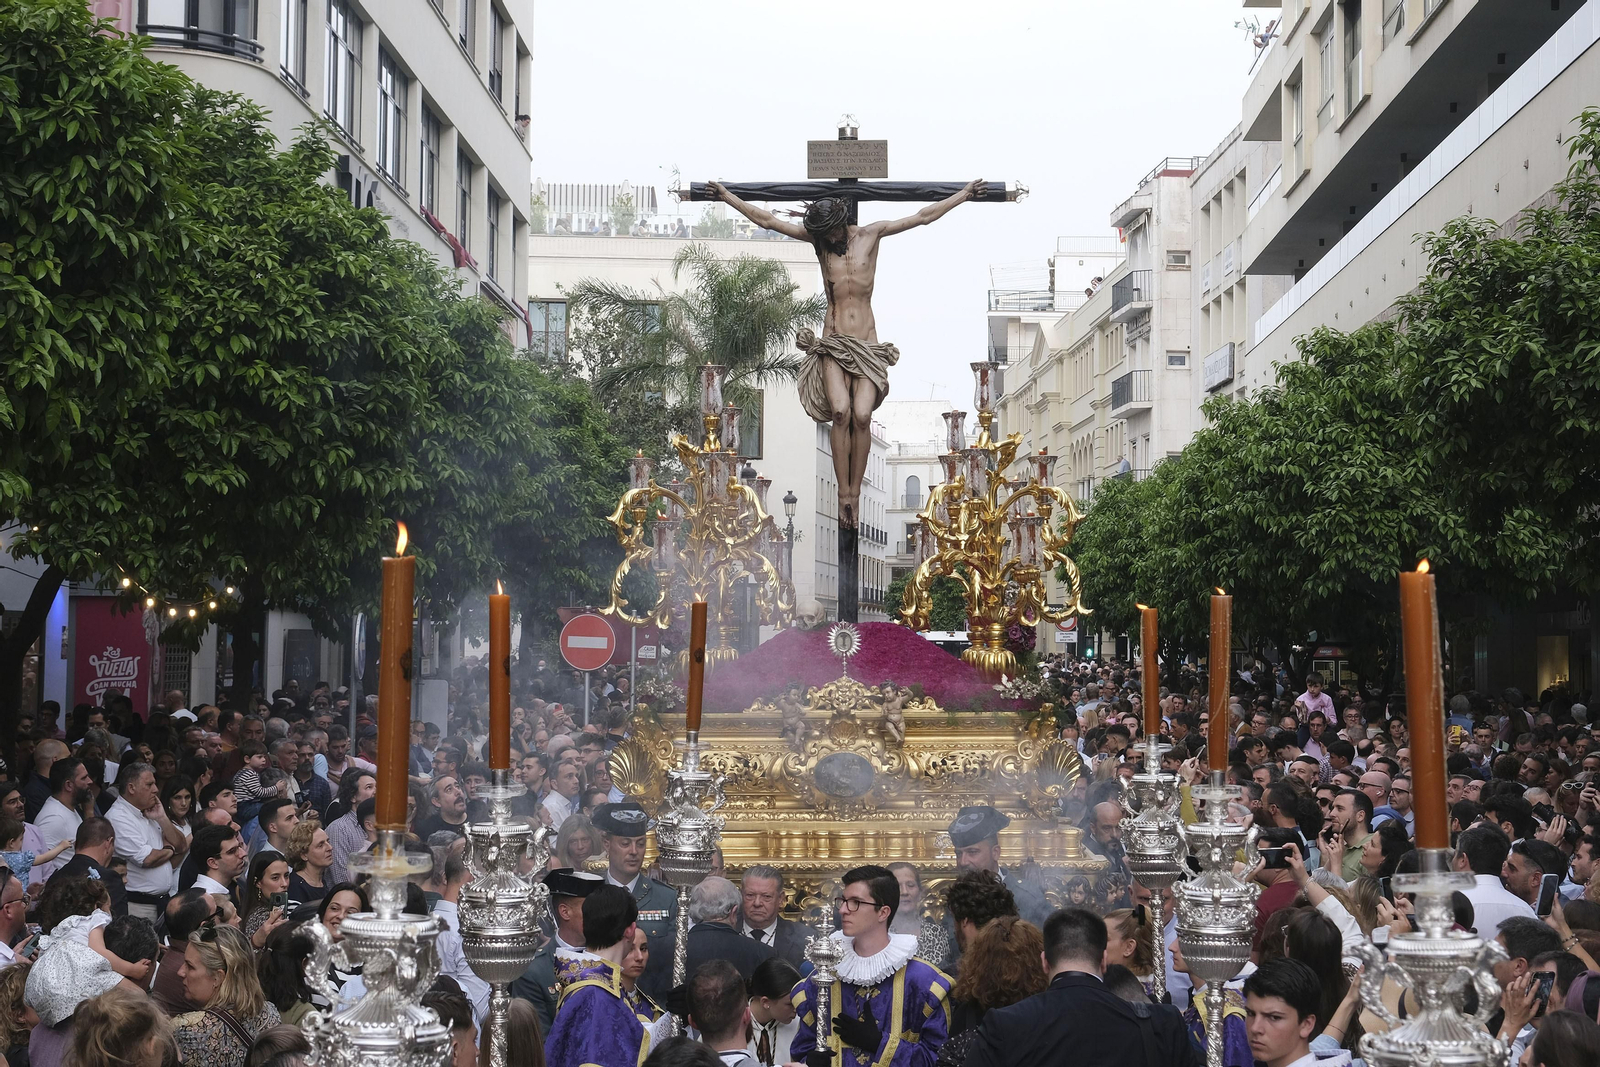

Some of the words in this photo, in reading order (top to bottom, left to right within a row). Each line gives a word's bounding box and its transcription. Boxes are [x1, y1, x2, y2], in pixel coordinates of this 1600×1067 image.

[102, 646, 121, 659] Las
[89, 655, 141, 678] VUELTAS
[94, 681, 109, 690] DAN
[110, 680, 137, 689] MUCHA
